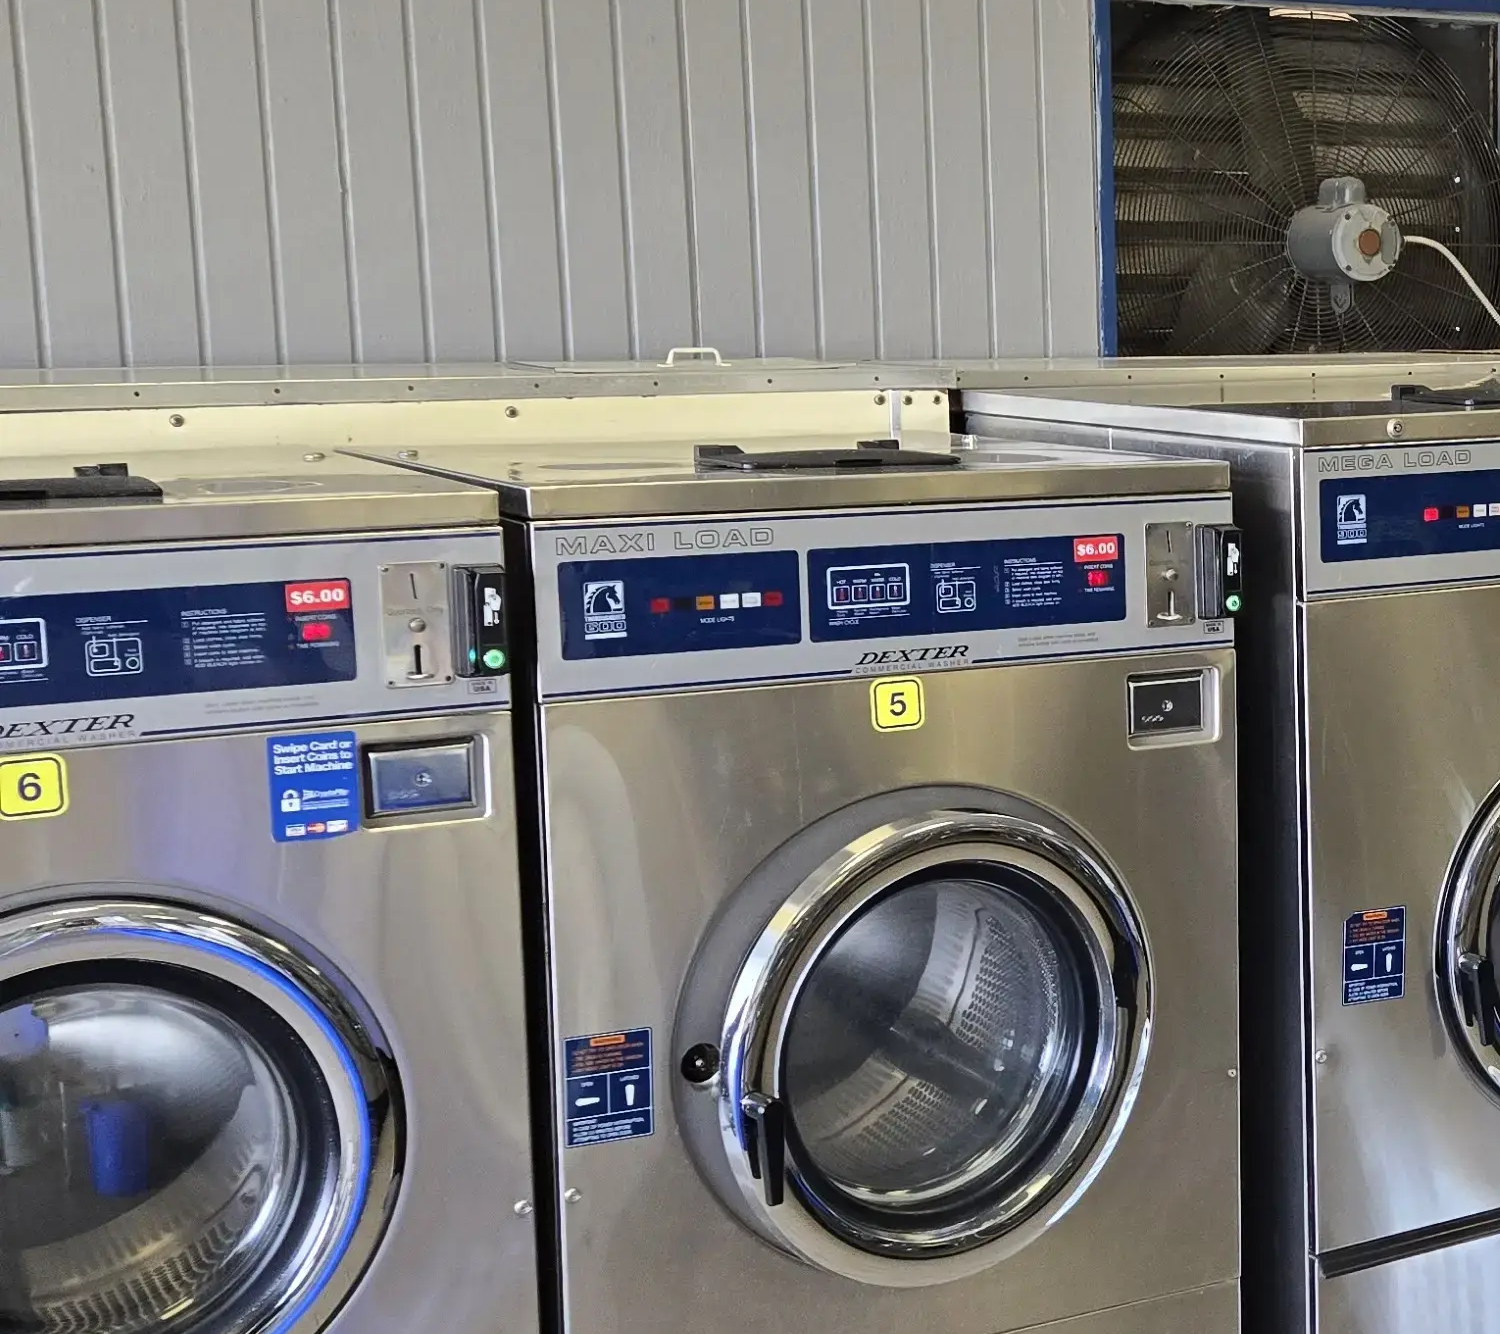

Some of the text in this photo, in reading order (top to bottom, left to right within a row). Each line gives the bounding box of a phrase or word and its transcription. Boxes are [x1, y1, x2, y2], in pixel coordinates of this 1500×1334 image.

[1318, 449, 1472, 472] MEGA LOAD
[555, 527, 774, 555] MAXI LOAD
[1076, 542, 1116, 556] $6.00
[289, 588, 345, 605] $6.00
[855, 645, 969, 665] DEXTER
[855, 658, 969, 674] COMMERCIAL WASHER
[890, 692, 907, 716] 5
[0, 714, 134, 738] EXTER
[273, 743, 309, 754] Swipe
[309, 740, 338, 751] Card
[274, 750, 353, 764] Insert Coins to
[274, 761, 354, 775] Start Machine
[18, 772, 41, 801] 6
